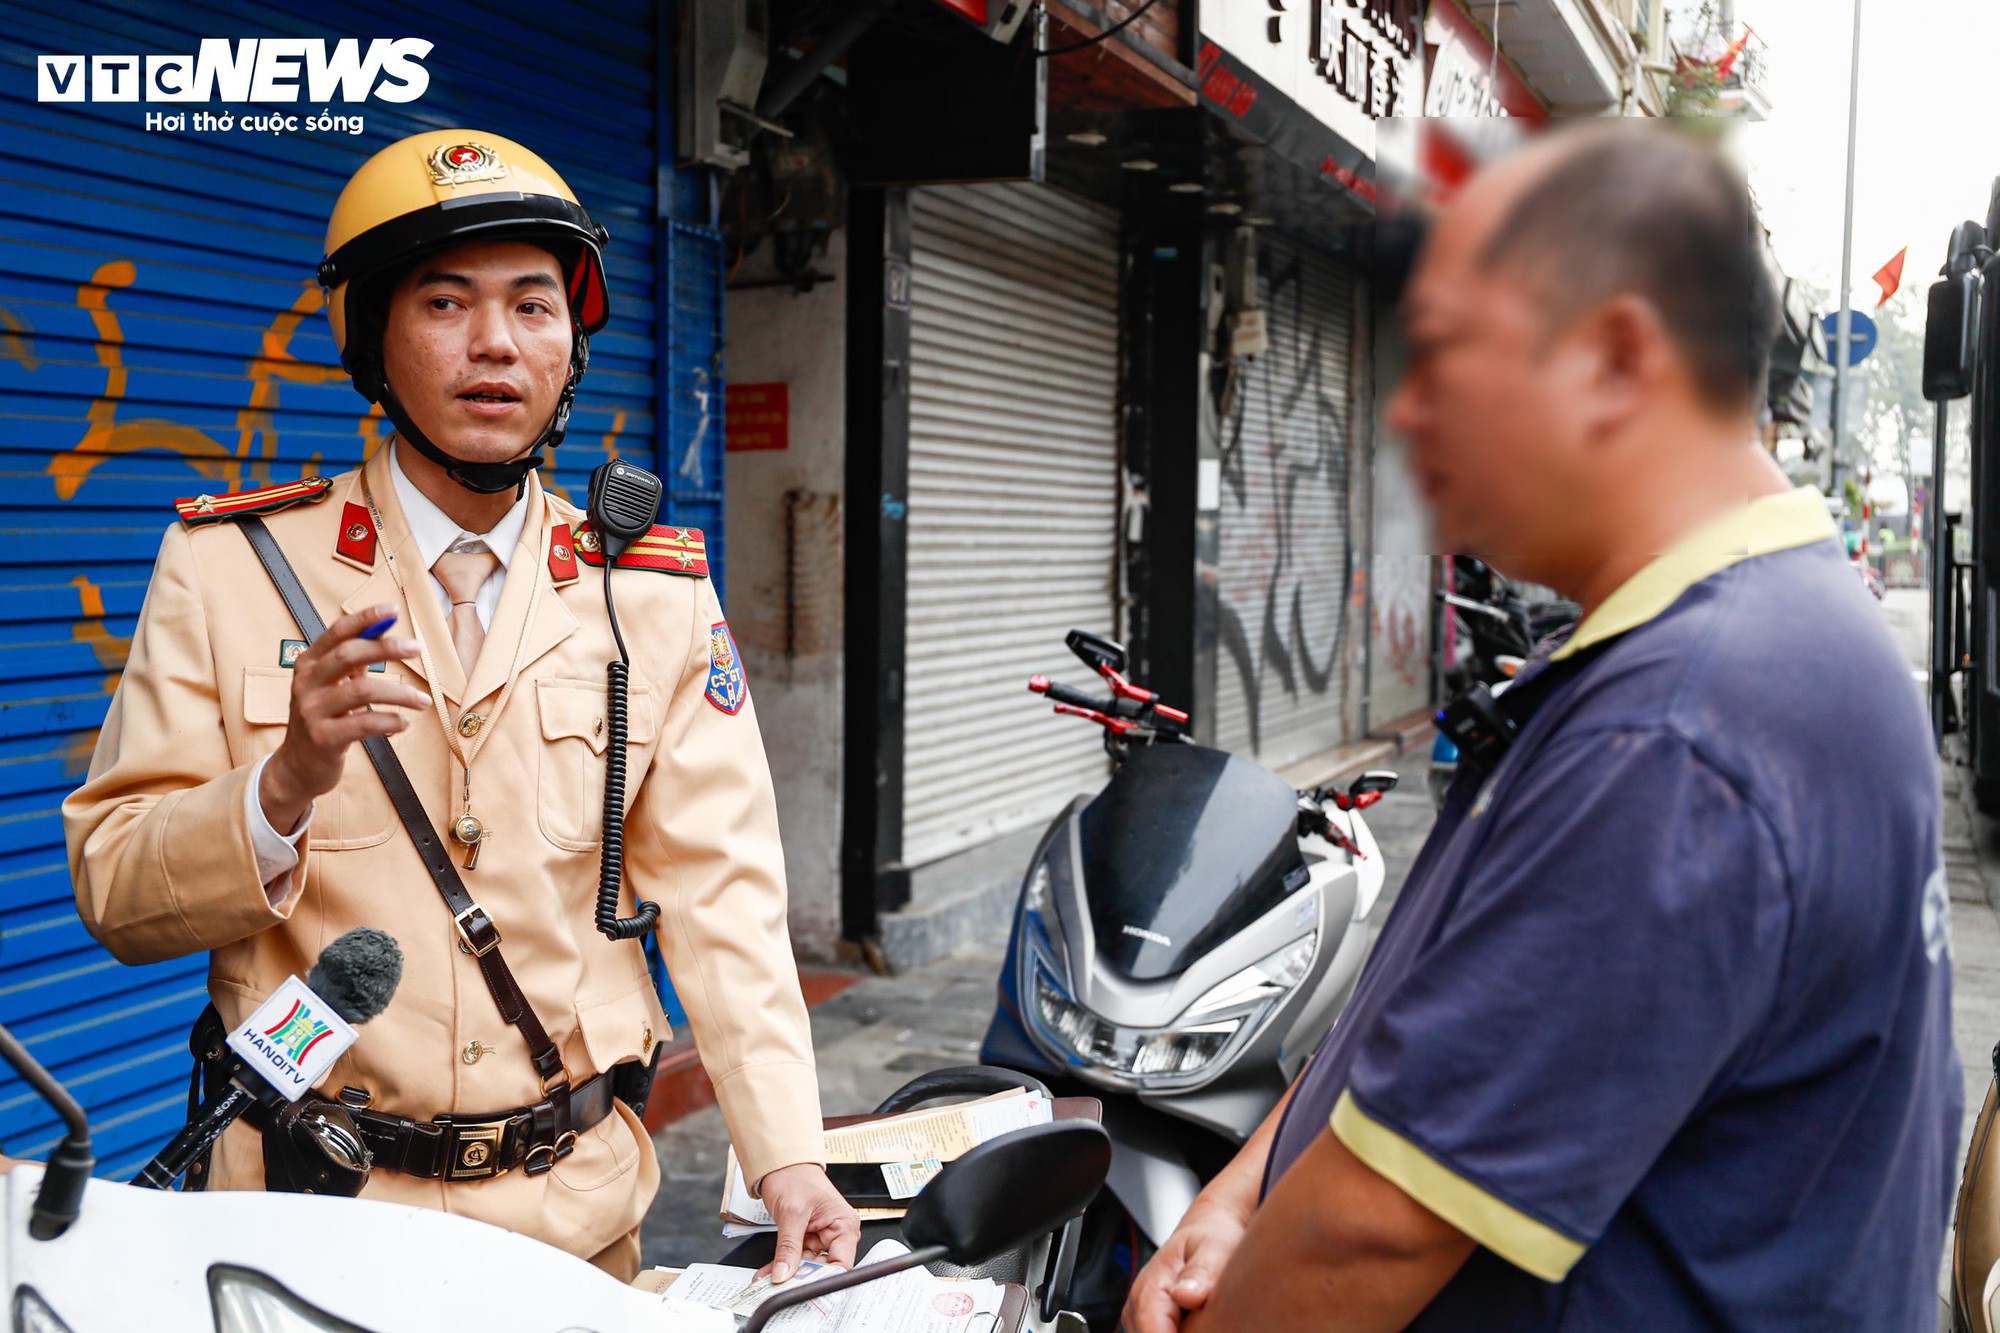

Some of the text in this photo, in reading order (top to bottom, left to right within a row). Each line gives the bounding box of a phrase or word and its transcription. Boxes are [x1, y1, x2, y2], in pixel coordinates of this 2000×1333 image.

[625, 471, 655, 486] MOTOROLA
[1122, 925, 1171, 947] HONDA
[243, 1028, 306, 1085] HANOITV
